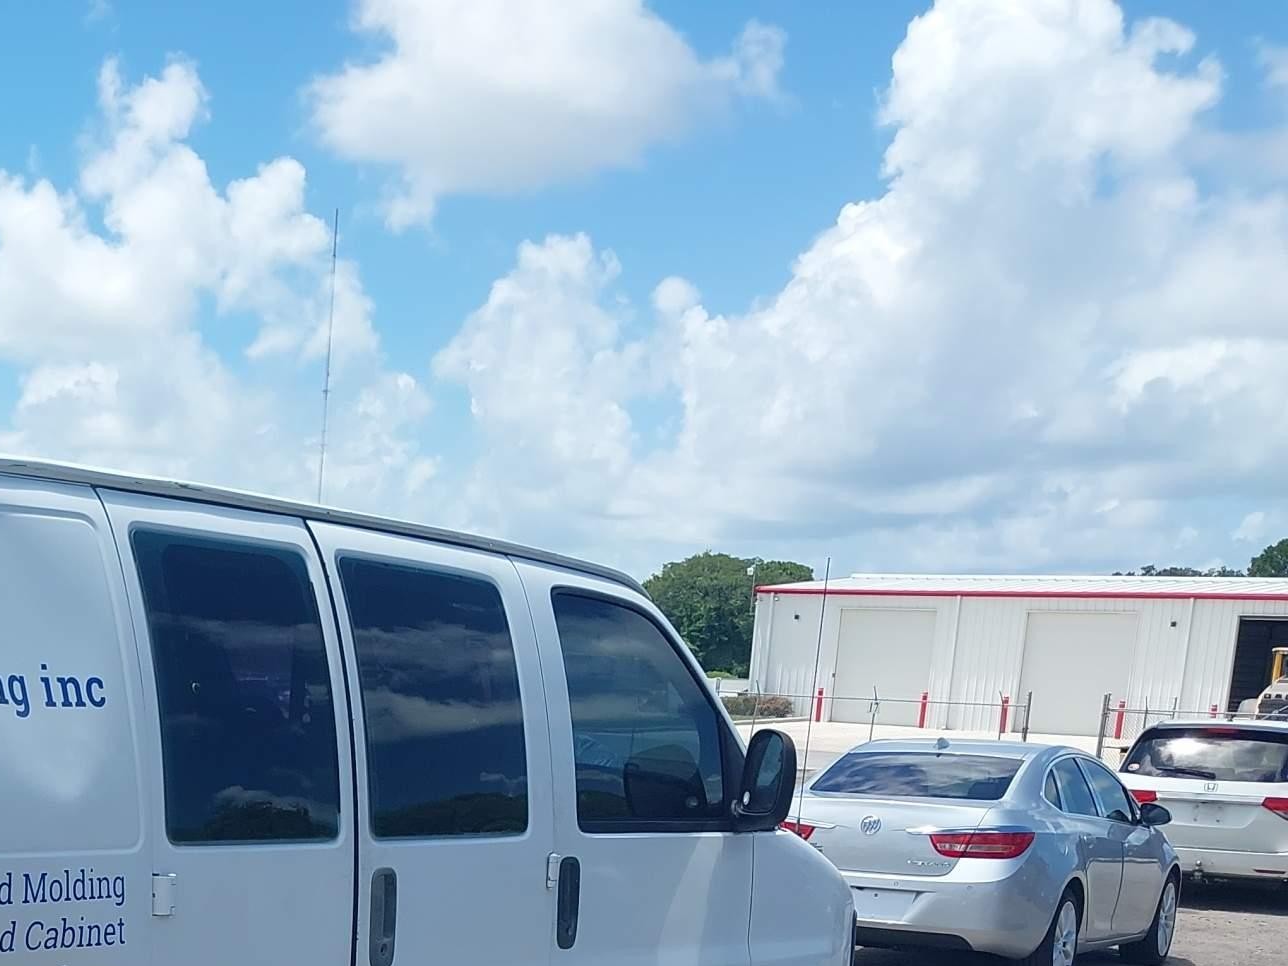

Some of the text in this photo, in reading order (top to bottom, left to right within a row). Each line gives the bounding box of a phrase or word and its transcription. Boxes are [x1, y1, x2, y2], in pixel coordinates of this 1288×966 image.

[40, 663, 106, 708] inc
[22, 867, 125, 907] Molding
[25, 916, 126, 951] Cabinet
